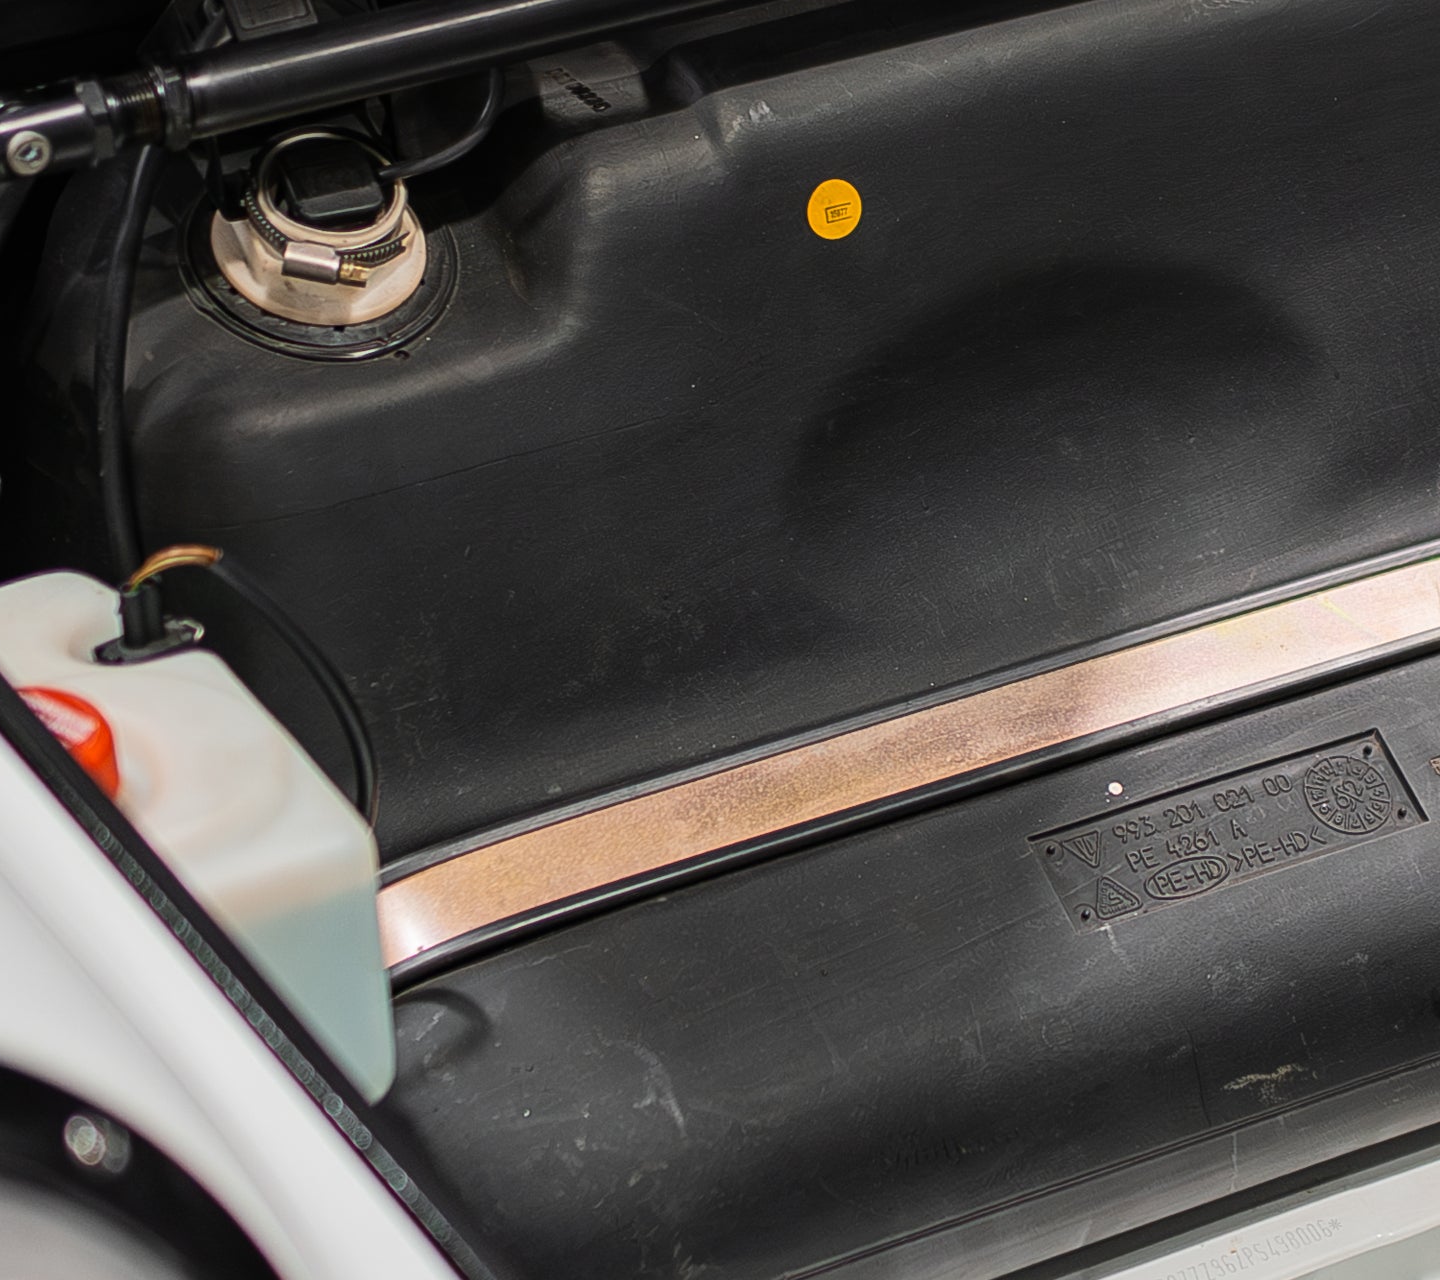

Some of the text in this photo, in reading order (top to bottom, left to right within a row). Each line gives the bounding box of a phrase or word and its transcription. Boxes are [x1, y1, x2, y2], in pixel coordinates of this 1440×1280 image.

[1262, 774, 1293, 797] 00
[1125, 846, 1160, 873] PE
[1151, 859, 1223, 896] PE-HD
